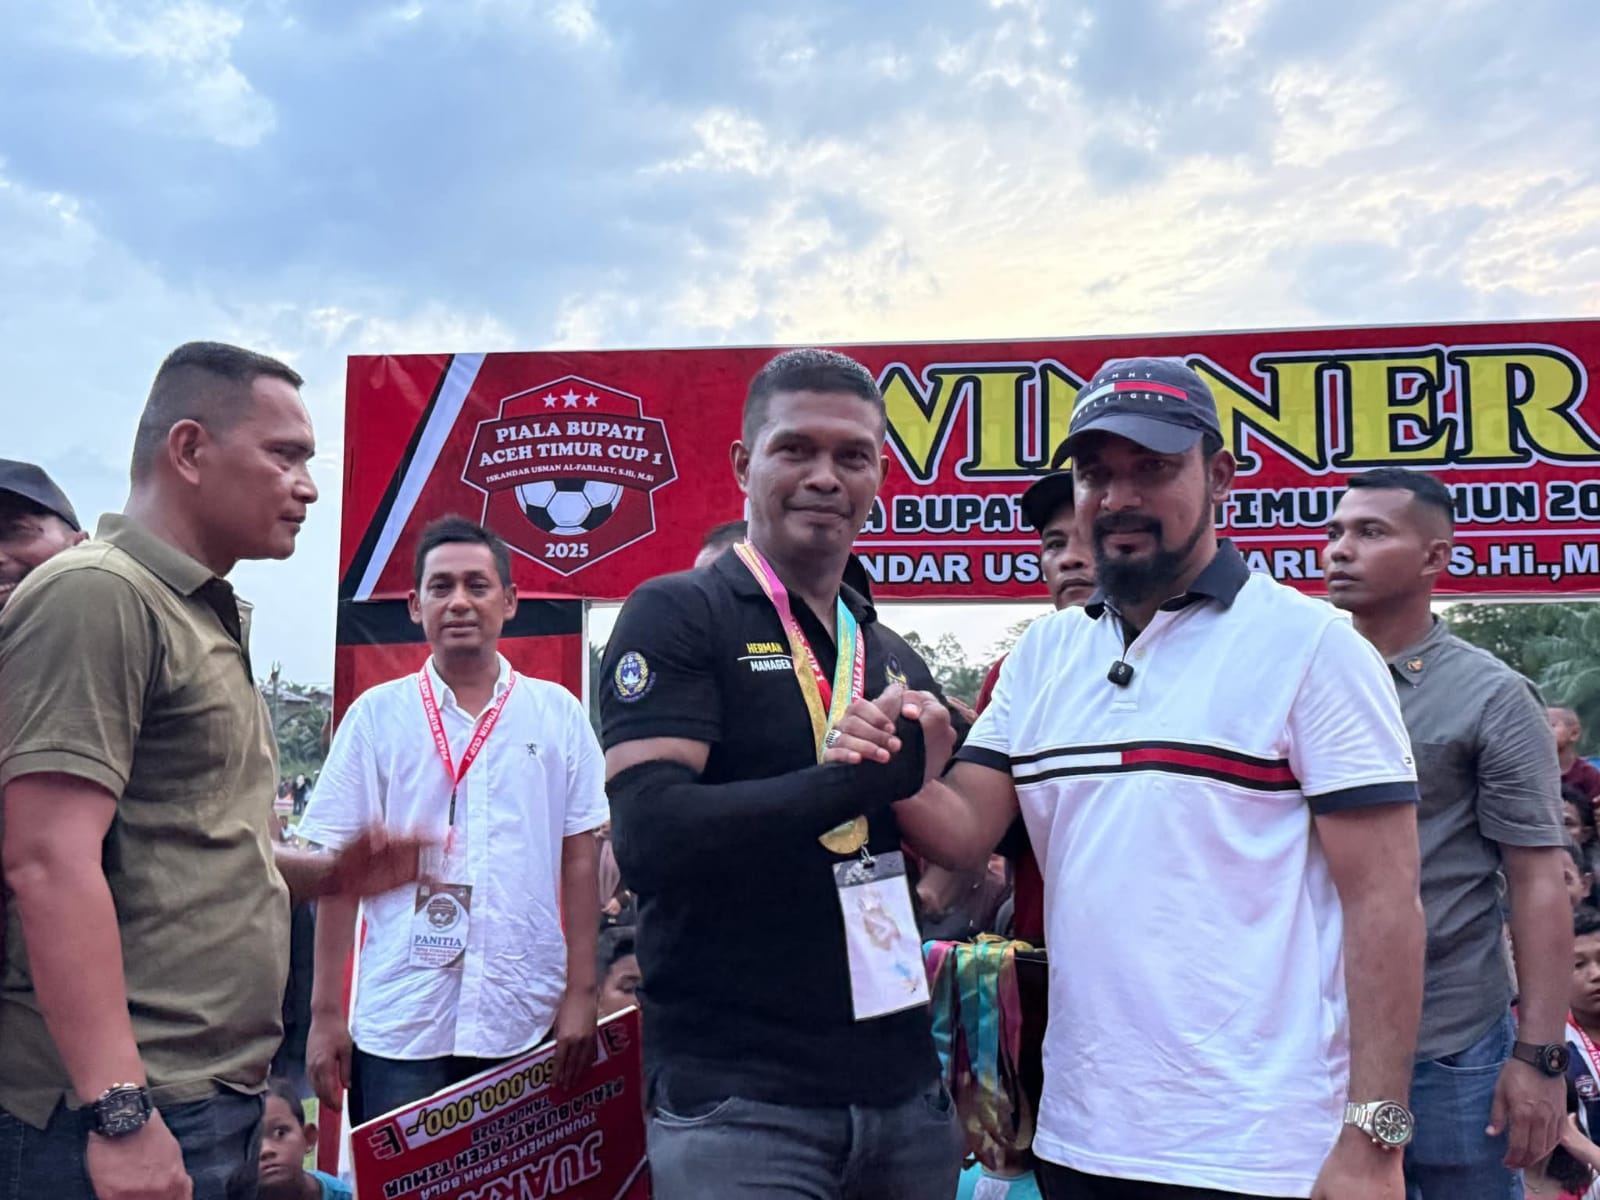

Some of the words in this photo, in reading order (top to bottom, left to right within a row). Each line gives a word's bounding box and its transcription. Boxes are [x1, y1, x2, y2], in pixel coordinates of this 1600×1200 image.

[1090, 372, 1152, 390] TOMMY
[876, 344, 1600, 485] WINER
[496, 422, 562, 443] PIALA
[566, 421, 646, 442] BUPATI
[479, 444, 533, 467] ACEH
[537, 442, 603, 457] TIMUR
[607, 445, 649, 462] CUP
[652, 452, 663, 466] 1
[486, 468, 530, 483] ISKANDAR
[531, 464, 562, 473] USMAN
[1213, 486, 1345, 529] TIMU
[545, 543, 589, 558] 2025
[746, 642, 783, 654] HERMAN
[415, 935, 462, 947] PANITIA
[505, 1101, 572, 1147] BUPATI
[455, 1137, 506, 1170] ACEH
[383, 1161, 452, 1199] TIMUR
